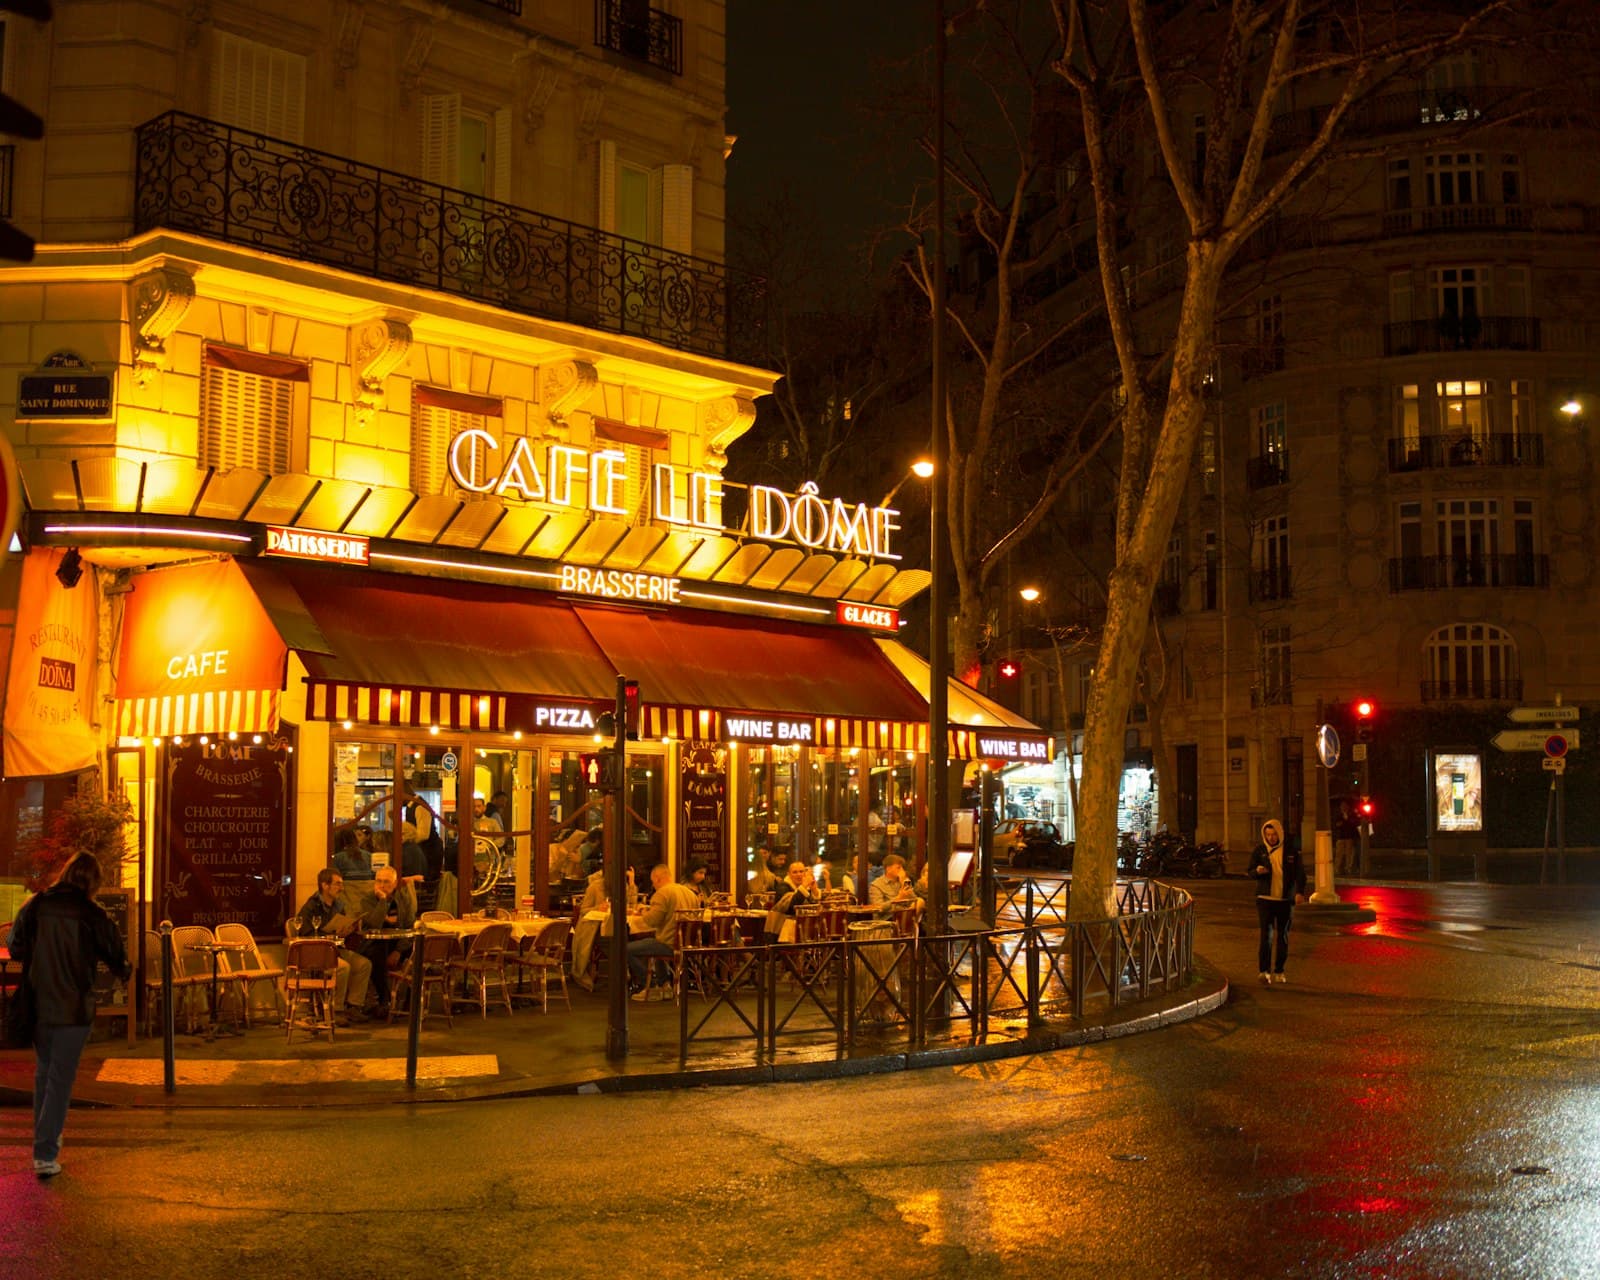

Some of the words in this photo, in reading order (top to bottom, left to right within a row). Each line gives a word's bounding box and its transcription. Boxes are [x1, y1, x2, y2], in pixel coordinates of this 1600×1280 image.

[54, 384, 77, 393] RUE
[21, 399, 50, 408] SAINT
[52, 399, 110, 410] DOMINIQUE
[655, 464, 726, 529] LE
[751, 481, 902, 559] DÔME
[561, 565, 681, 603] BRASSERIE
[844, 606, 892, 627] GLACES
[30, 624, 87, 662] RESTAURANT
[167, 650, 229, 679] CAFE
[40, 662, 72, 689] DOÏNA
[536, 707, 595, 728] PIZZA
[726, 719, 773, 738] WINE
[777, 722, 812, 740] BAR
[980, 739, 1017, 756] WINE
[1020, 742, 1046, 758] BAR
[196, 763, 262, 785] BRASSERIE
[696, 762, 712, 774] LE
[184, 806, 270, 818] CHARCUTERIE
[184, 822, 270, 833] CHOUCROUTE
[185, 838, 216, 849] PLAT
[240, 837, 269, 849] JOUR
[192, 853, 262, 865] GRILLADES
[212, 886, 241, 897] VINS
